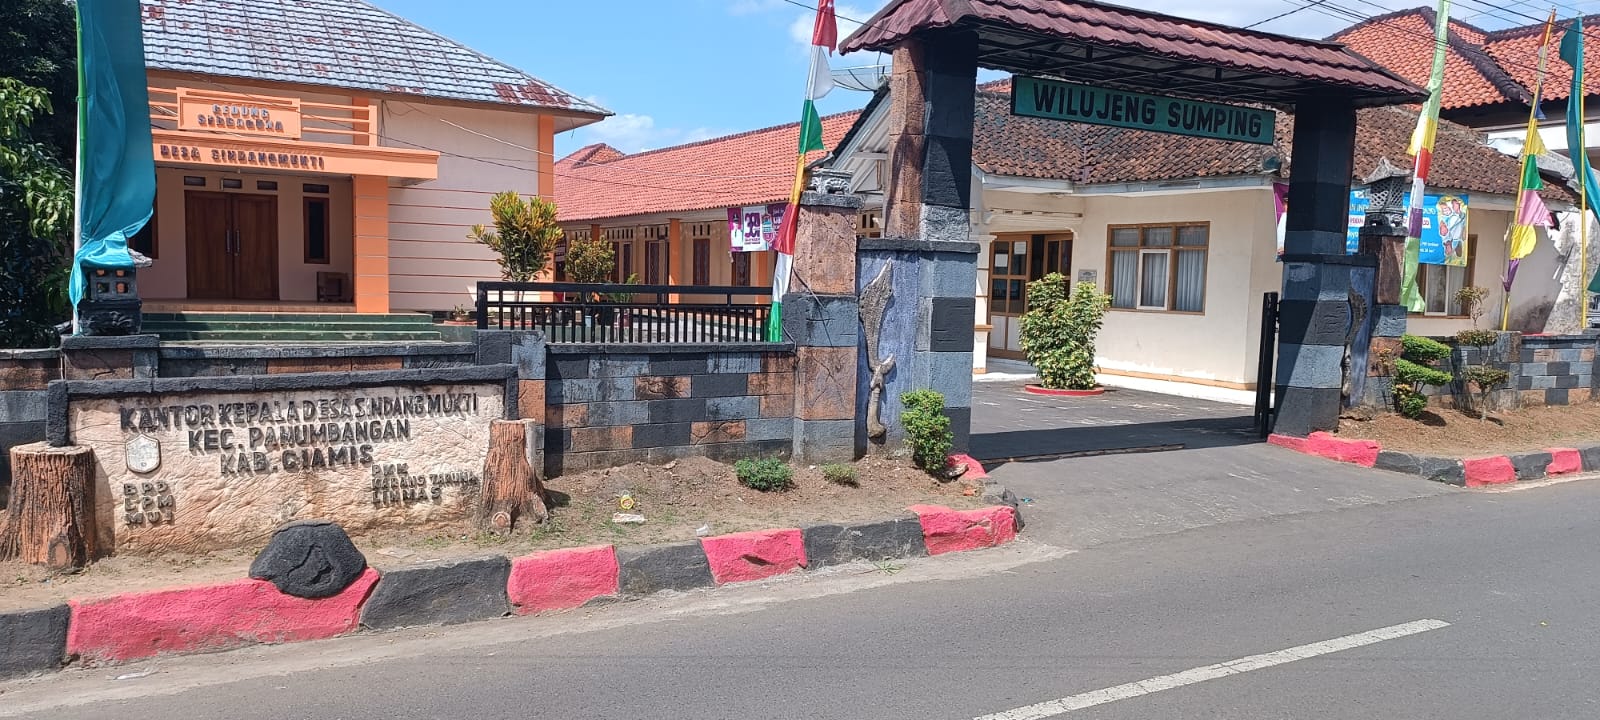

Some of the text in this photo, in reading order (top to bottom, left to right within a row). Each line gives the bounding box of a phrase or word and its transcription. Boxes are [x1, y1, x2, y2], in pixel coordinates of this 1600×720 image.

[1033, 83, 1262, 138] WILUJENG SUMPING
[160, 145, 200, 159] DESA
[119, 404, 214, 430] KANTOR
[218, 400, 300, 424] KEPALA
[302, 398, 350, 421] DESA
[188, 428, 244, 451] KEC.
[220, 451, 278, 474] KAB.
[124, 482, 169, 495] BPD
[125, 495, 174, 511] LPM
